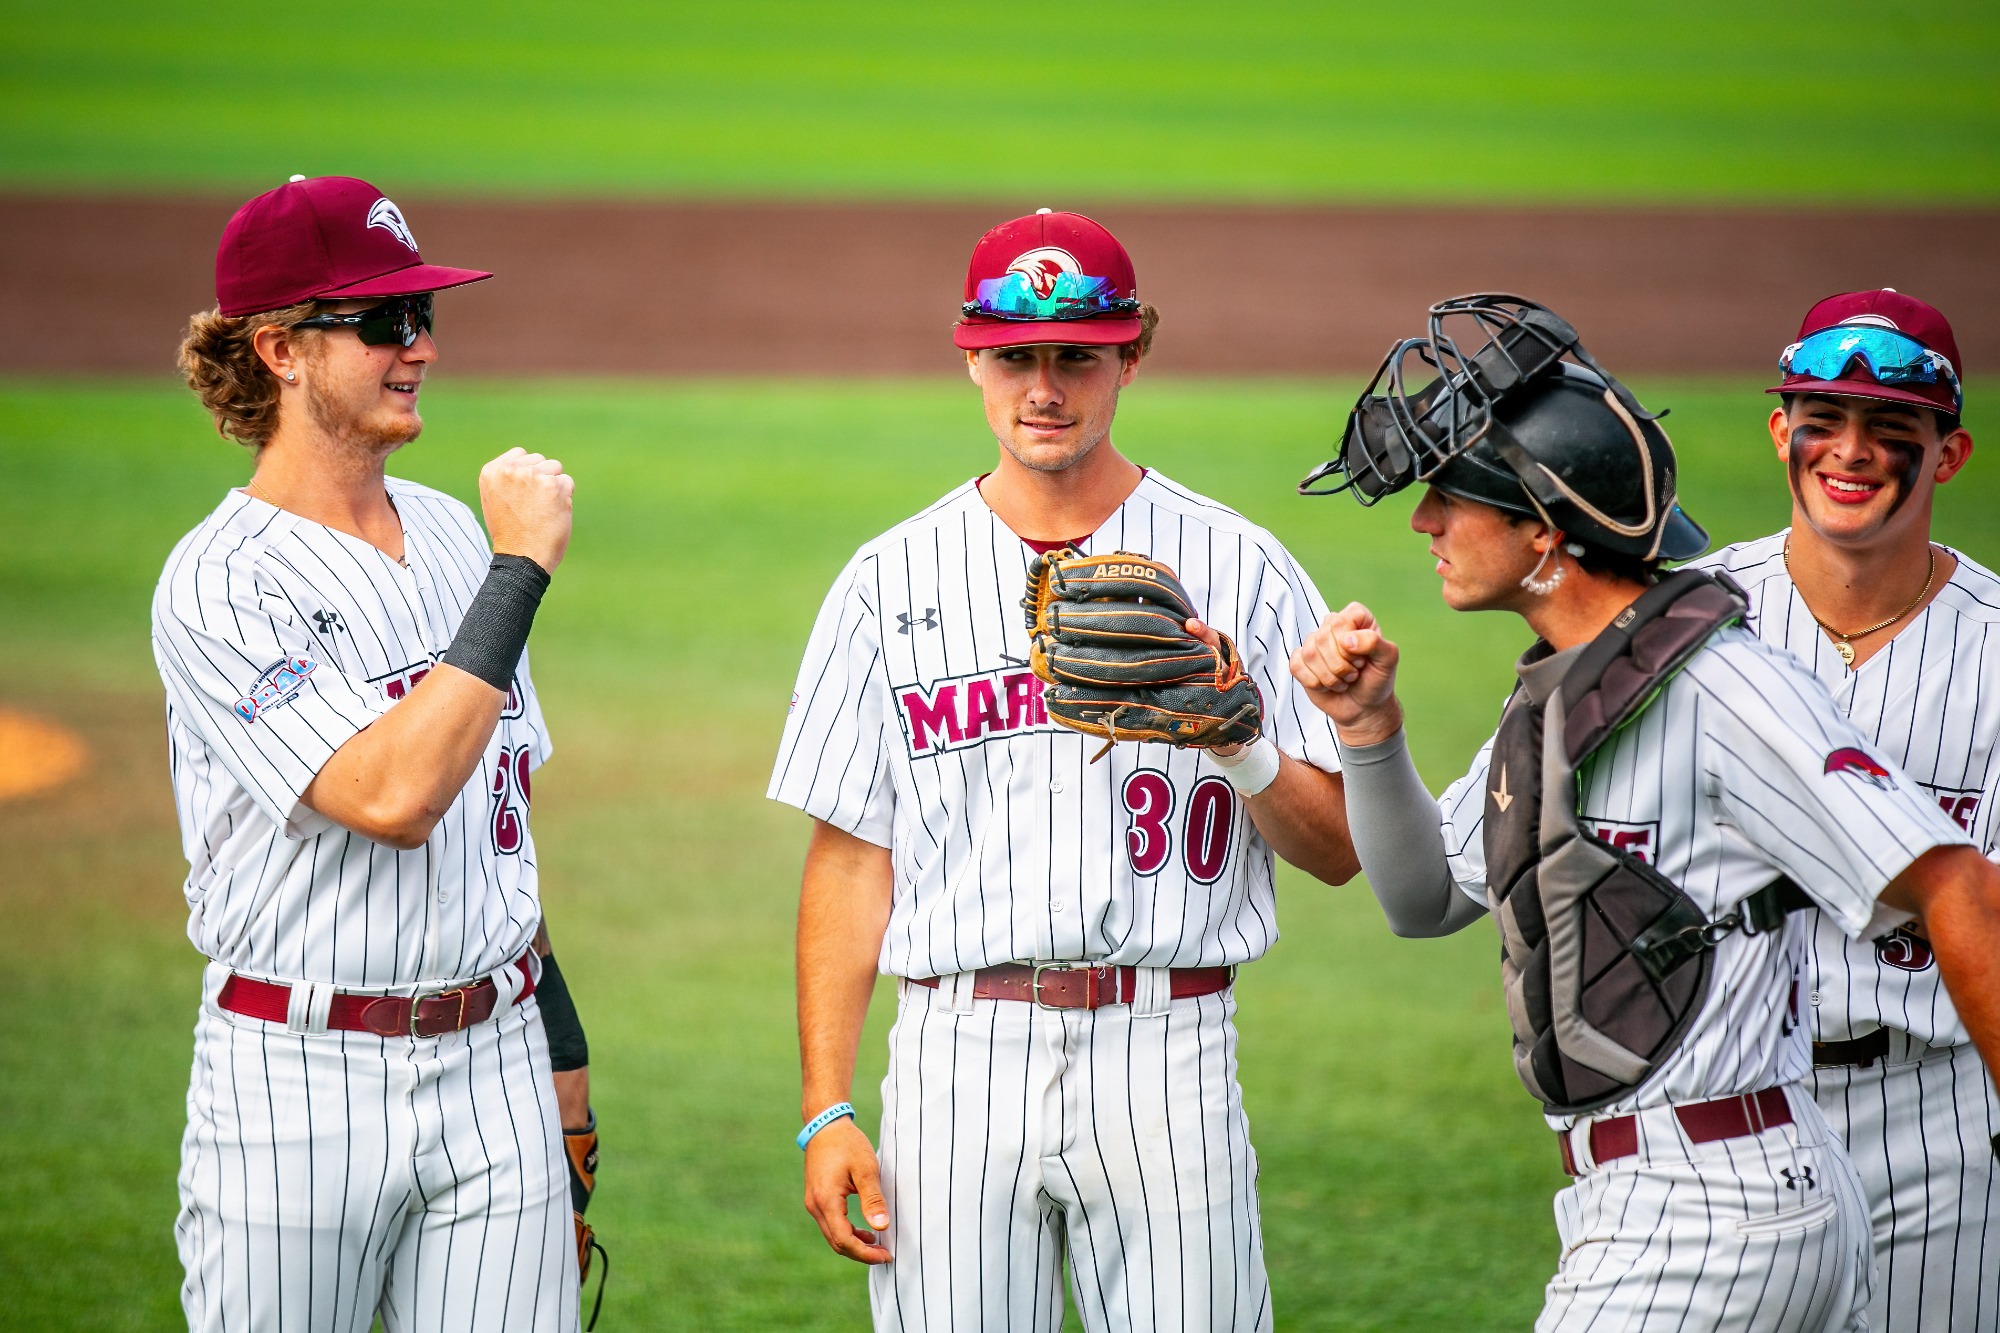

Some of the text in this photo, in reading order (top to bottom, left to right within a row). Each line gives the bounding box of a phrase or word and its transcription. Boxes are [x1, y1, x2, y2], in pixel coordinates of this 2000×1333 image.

[1093, 564, 1157, 580] A2000
[234, 656, 318, 724] ODAC
[1121, 768, 1236, 885] 30
